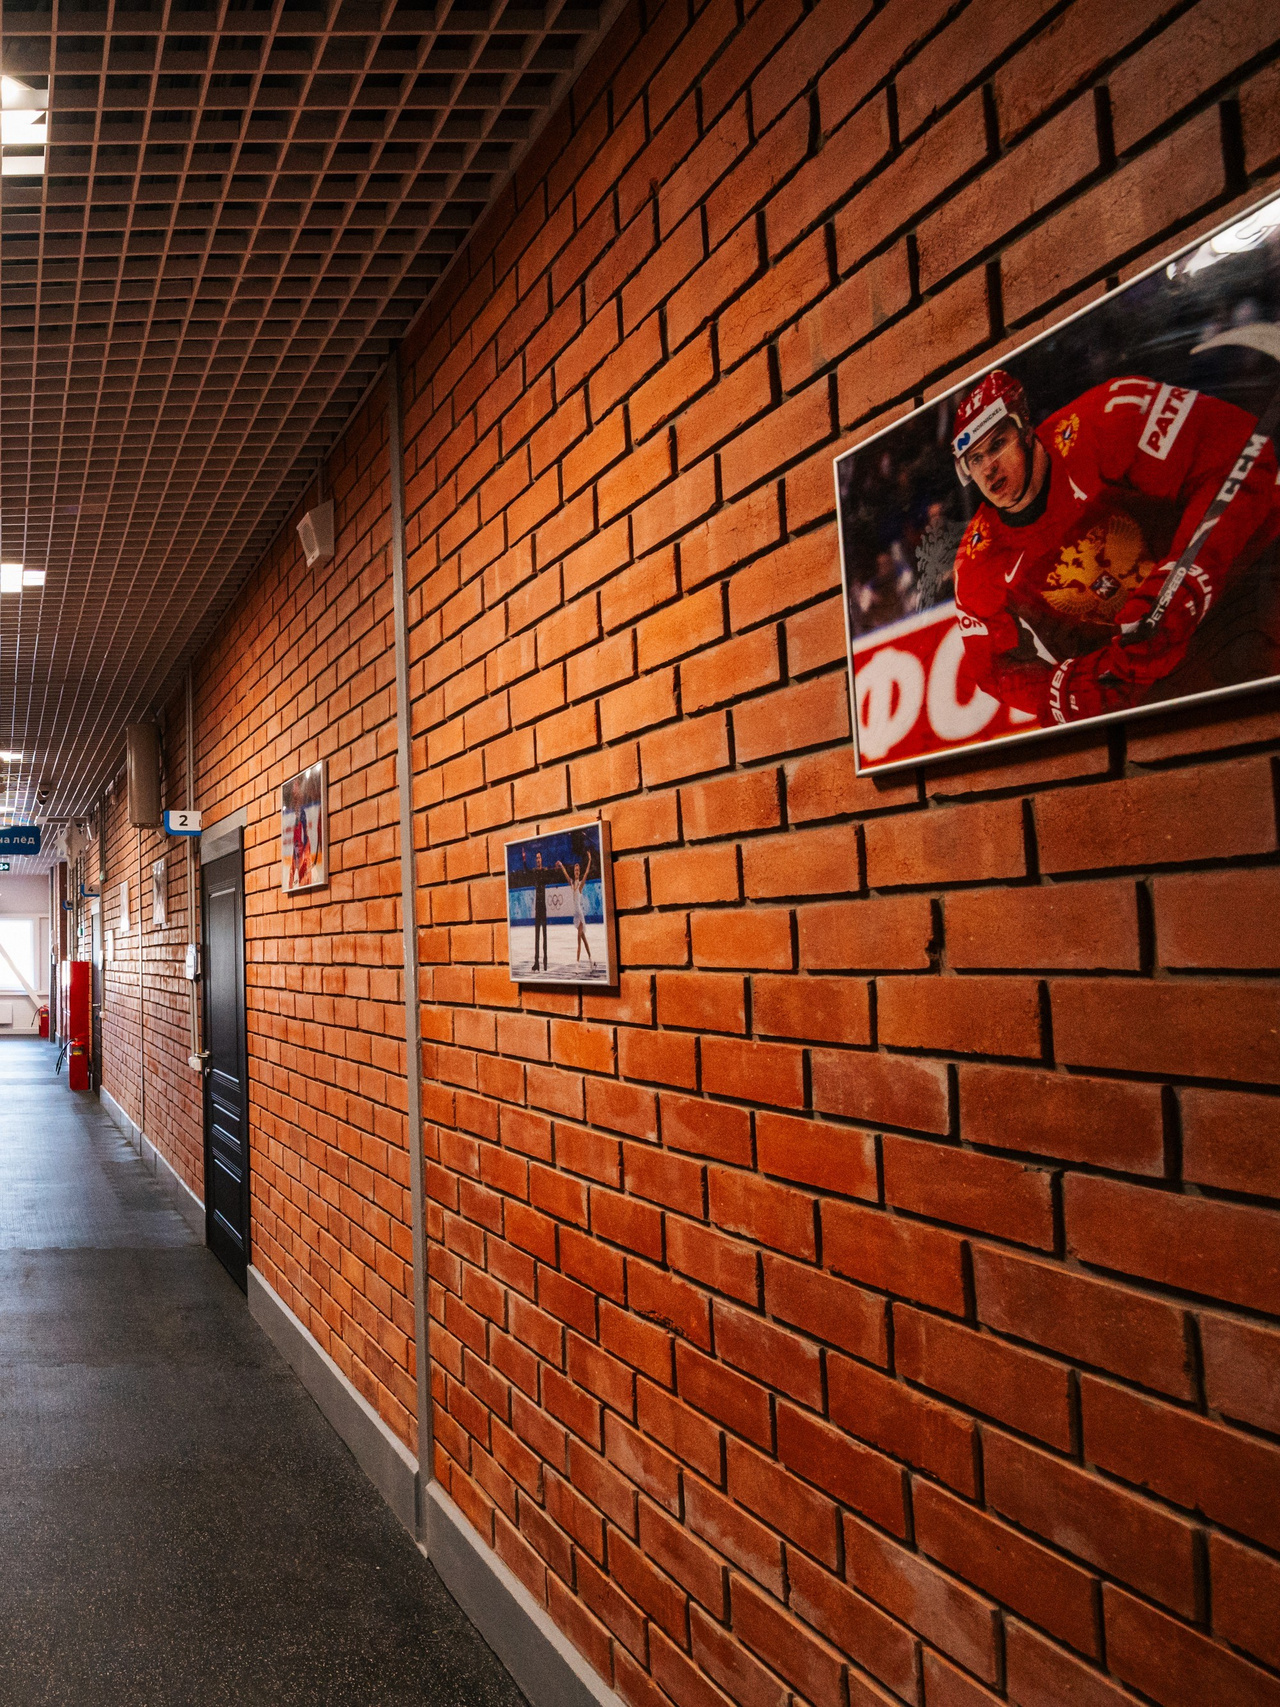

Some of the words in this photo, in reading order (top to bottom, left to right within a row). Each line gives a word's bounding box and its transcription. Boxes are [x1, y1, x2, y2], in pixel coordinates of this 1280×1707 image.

[972, 407, 1003, 434] NORNICKEL
[1147, 387, 1190, 453] PATR
[1216, 434, 1269, 502] CCM
[1145, 566, 1187, 628] JETSPEED
[1049, 658, 1074, 724] AUER
[12, 835, 35, 845] лёд
[179, 814, 188, 827] 2
